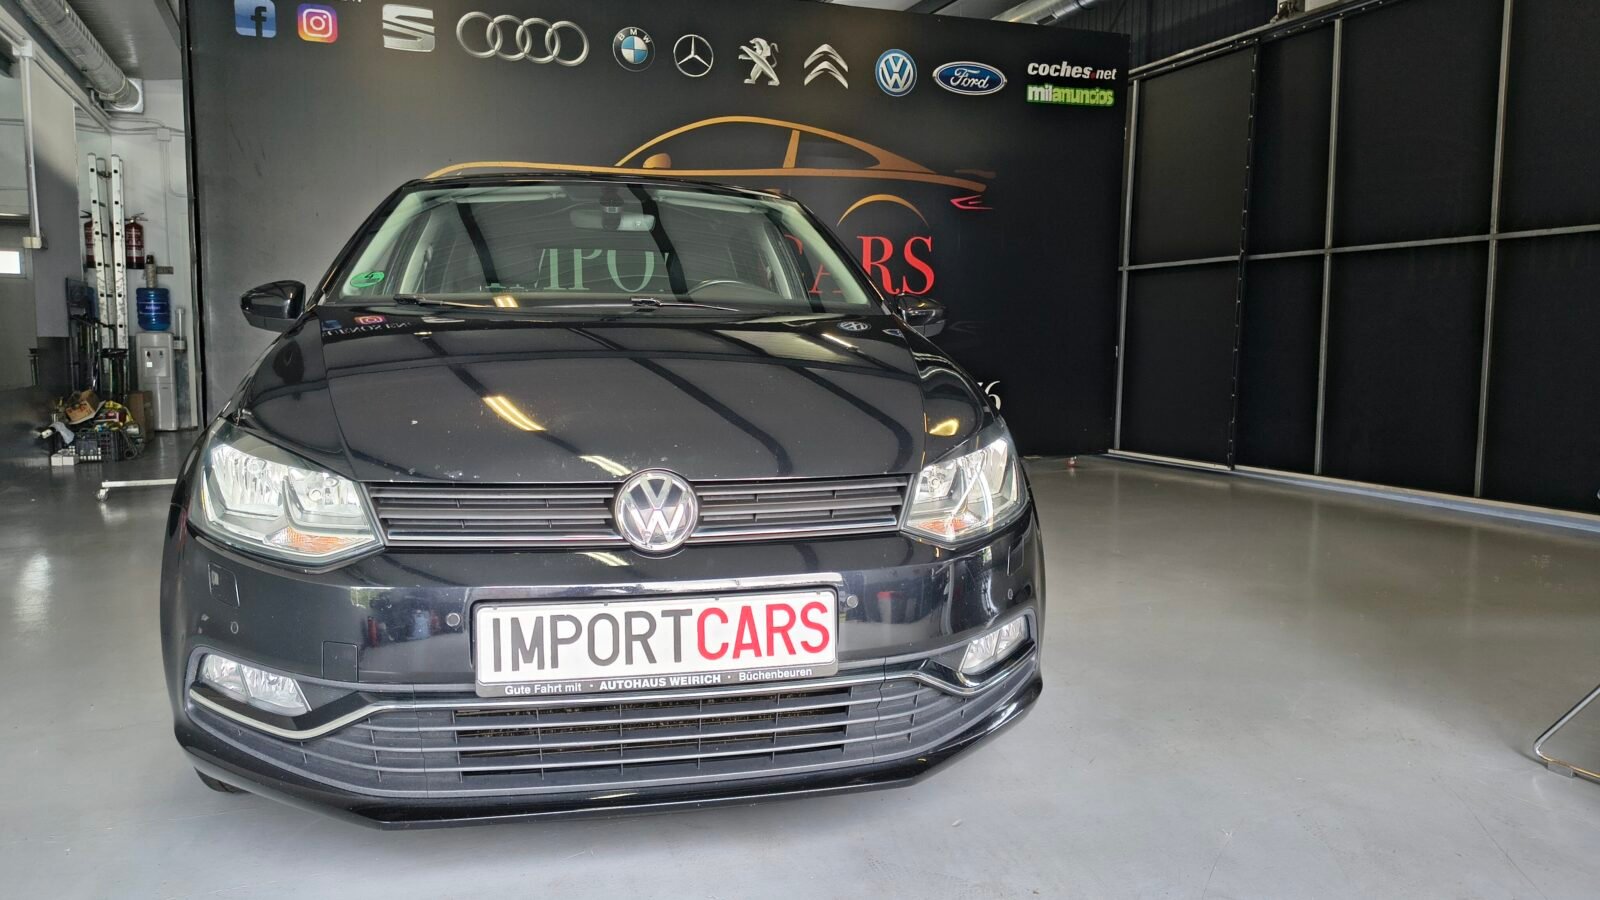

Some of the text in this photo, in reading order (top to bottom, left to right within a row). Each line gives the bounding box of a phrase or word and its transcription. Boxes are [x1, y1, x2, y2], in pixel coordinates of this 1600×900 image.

[617, 28, 651, 43] BMW
[950, 67, 990, 89] Ford
[1027, 61, 1117, 80] coches.net
[1027, 83, 1114, 106] milanuncios
[504, 668, 812, 695] Gute Fahrt mit AUTOHAUS WEIRICH Büchenbeuren
